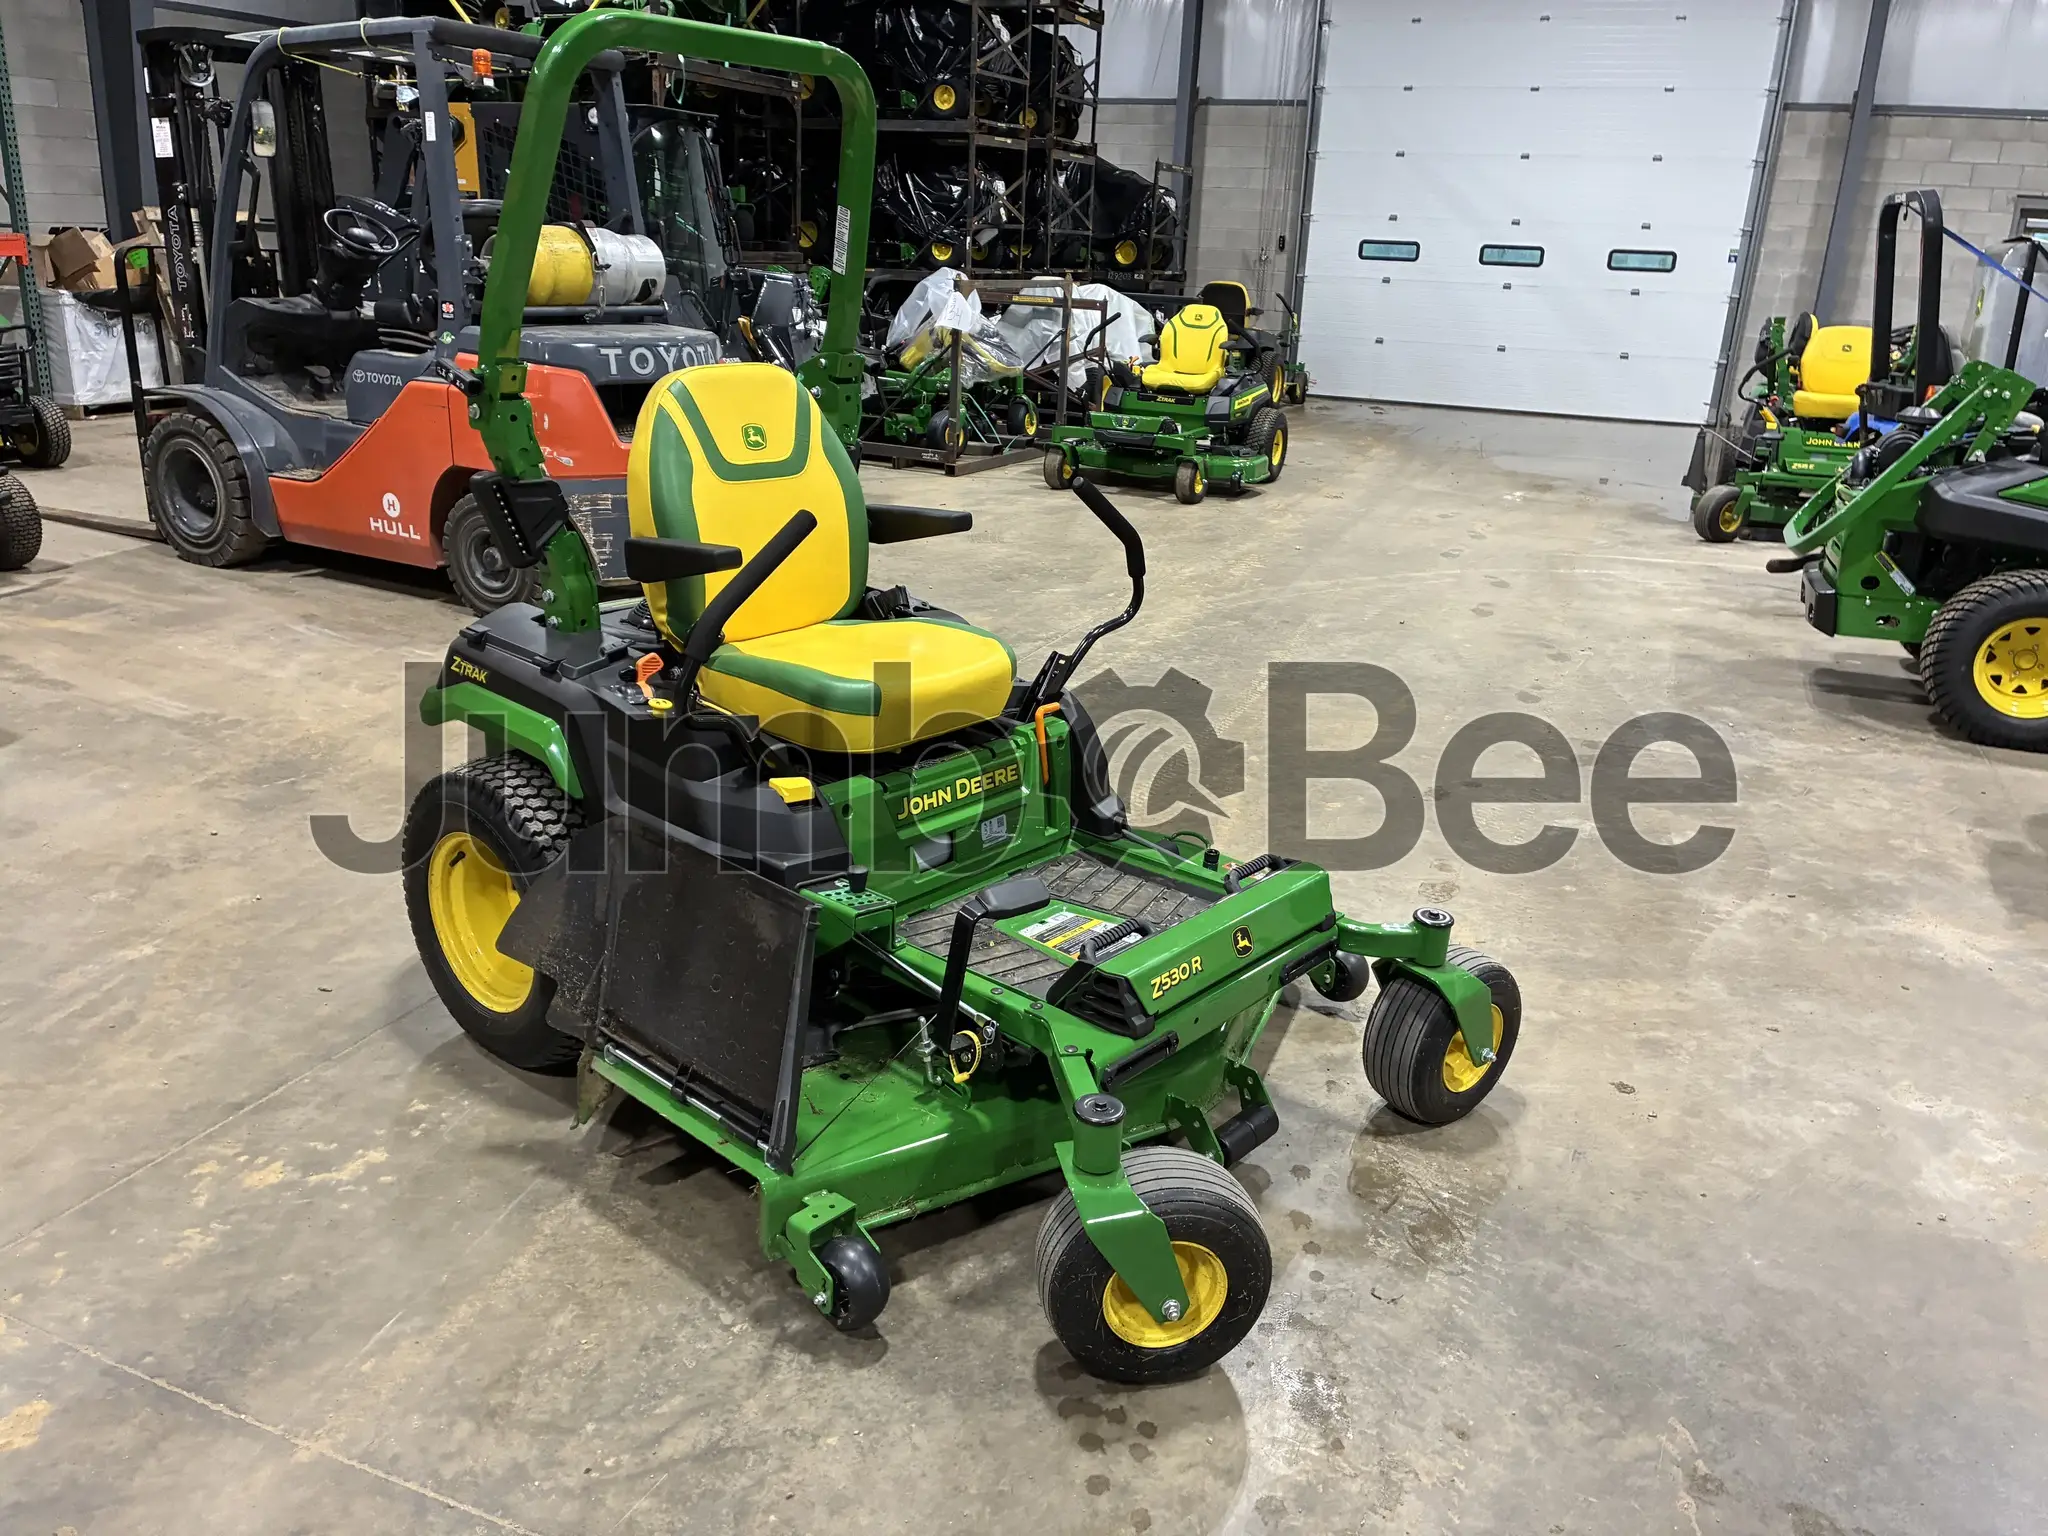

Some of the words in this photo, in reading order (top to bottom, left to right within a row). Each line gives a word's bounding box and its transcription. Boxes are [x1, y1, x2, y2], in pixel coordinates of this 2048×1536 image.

[167, 205, 188, 292] TOYOTA
[599, 343, 716, 376] TOYOTA
[366, 371, 403, 387] TOYOTA
[1156, 395, 1176, 404] ZTRAK
[1806, 437, 1832, 447] JOHN
[369, 516, 421, 540] HULL
[450, 655, 488, 684] ZTRAK
[897, 785, 952, 820] JOHN
[955, 763, 1019, 800] DEERE
[1150, 962, 1190, 1000] Z530
[1191, 955, 1204, 973] R
